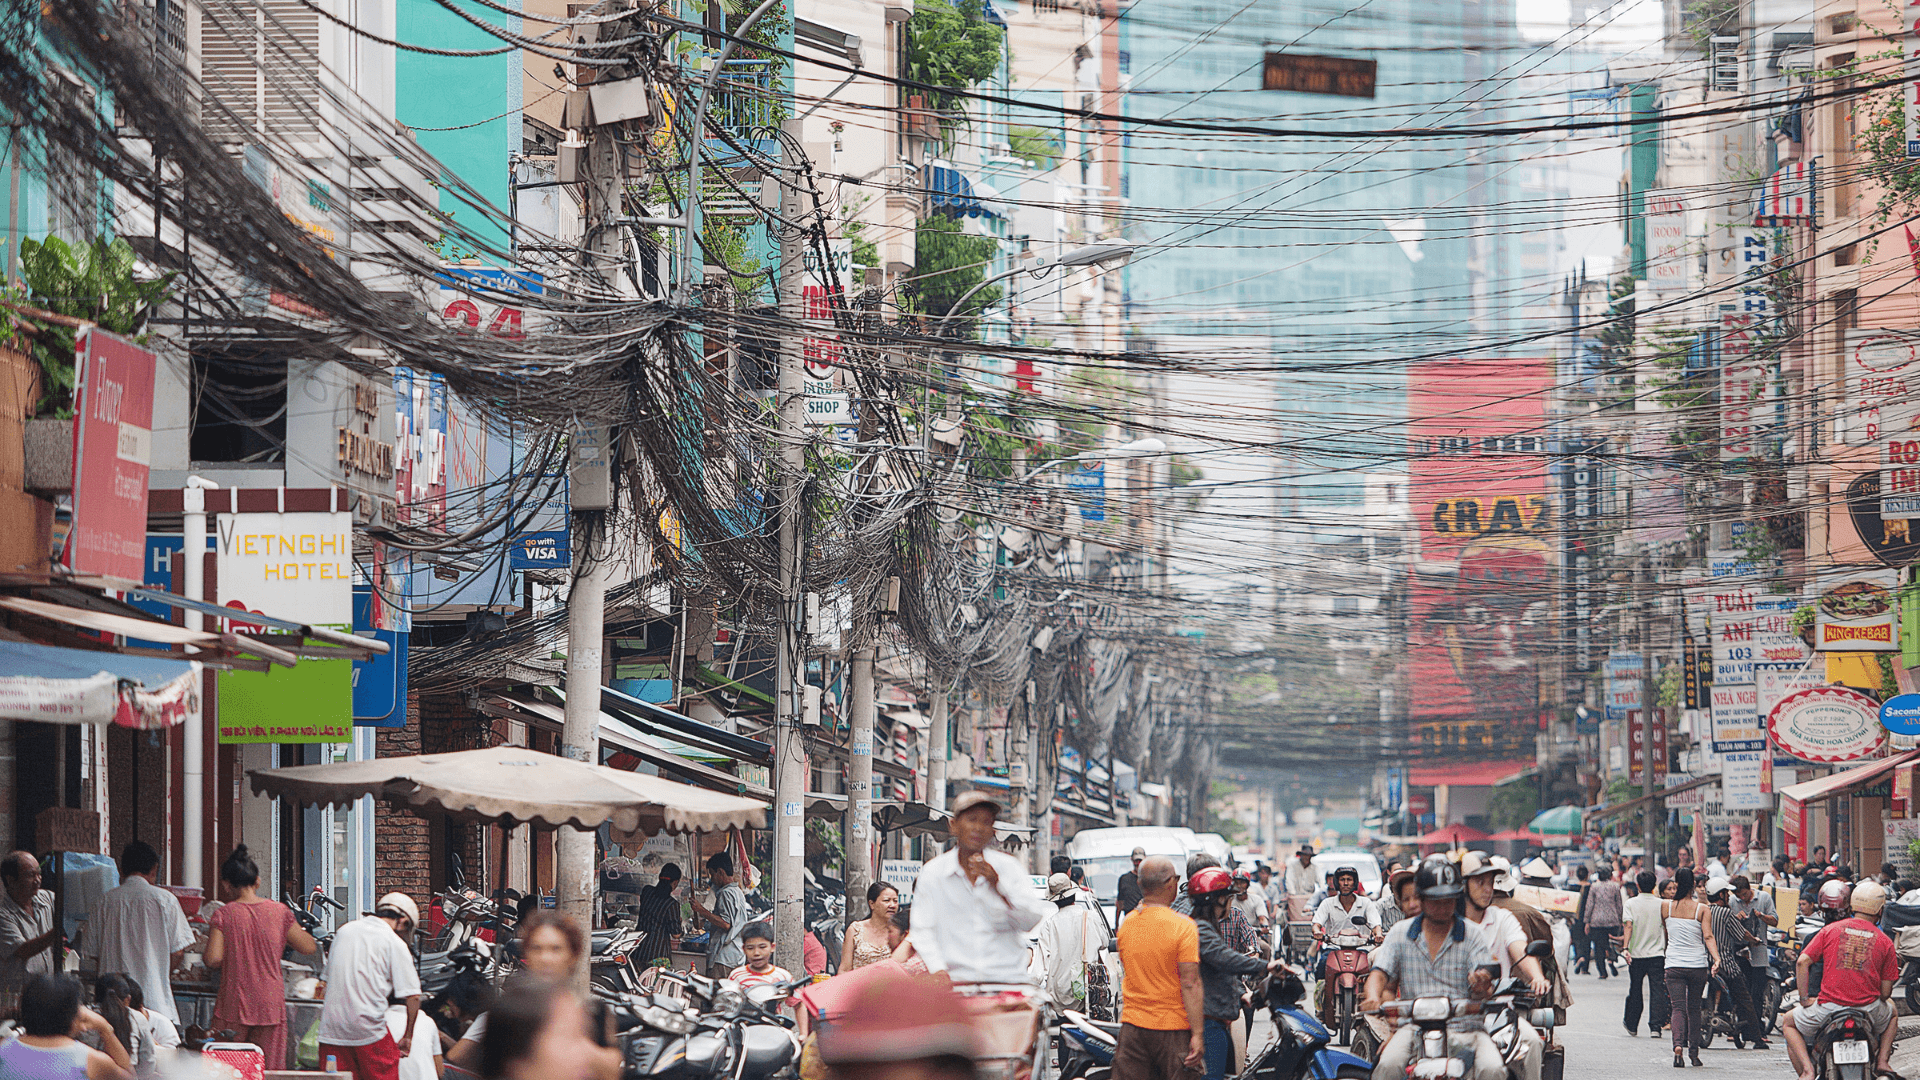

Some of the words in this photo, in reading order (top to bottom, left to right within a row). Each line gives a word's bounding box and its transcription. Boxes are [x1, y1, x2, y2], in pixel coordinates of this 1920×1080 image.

[1653, 226, 1681, 238] ROOM
[1656, 265, 1681, 277] RENT
[808, 402, 840, 414] SHOP
[1889, 440, 1920, 465] RO
[219, 519, 346, 555] VIETNGHI
[537, 537, 555, 545] with
[524, 547, 558, 559] VISA
[264, 563, 349, 580] HOTEL
[1826, 627, 1852, 640] KING
[1853, 627, 1888, 640] KEBAB
[1728, 647, 1753, 661] 103
[1718, 663, 1736, 674] BÙI
[1827, 738, 1844, 746] HOA
